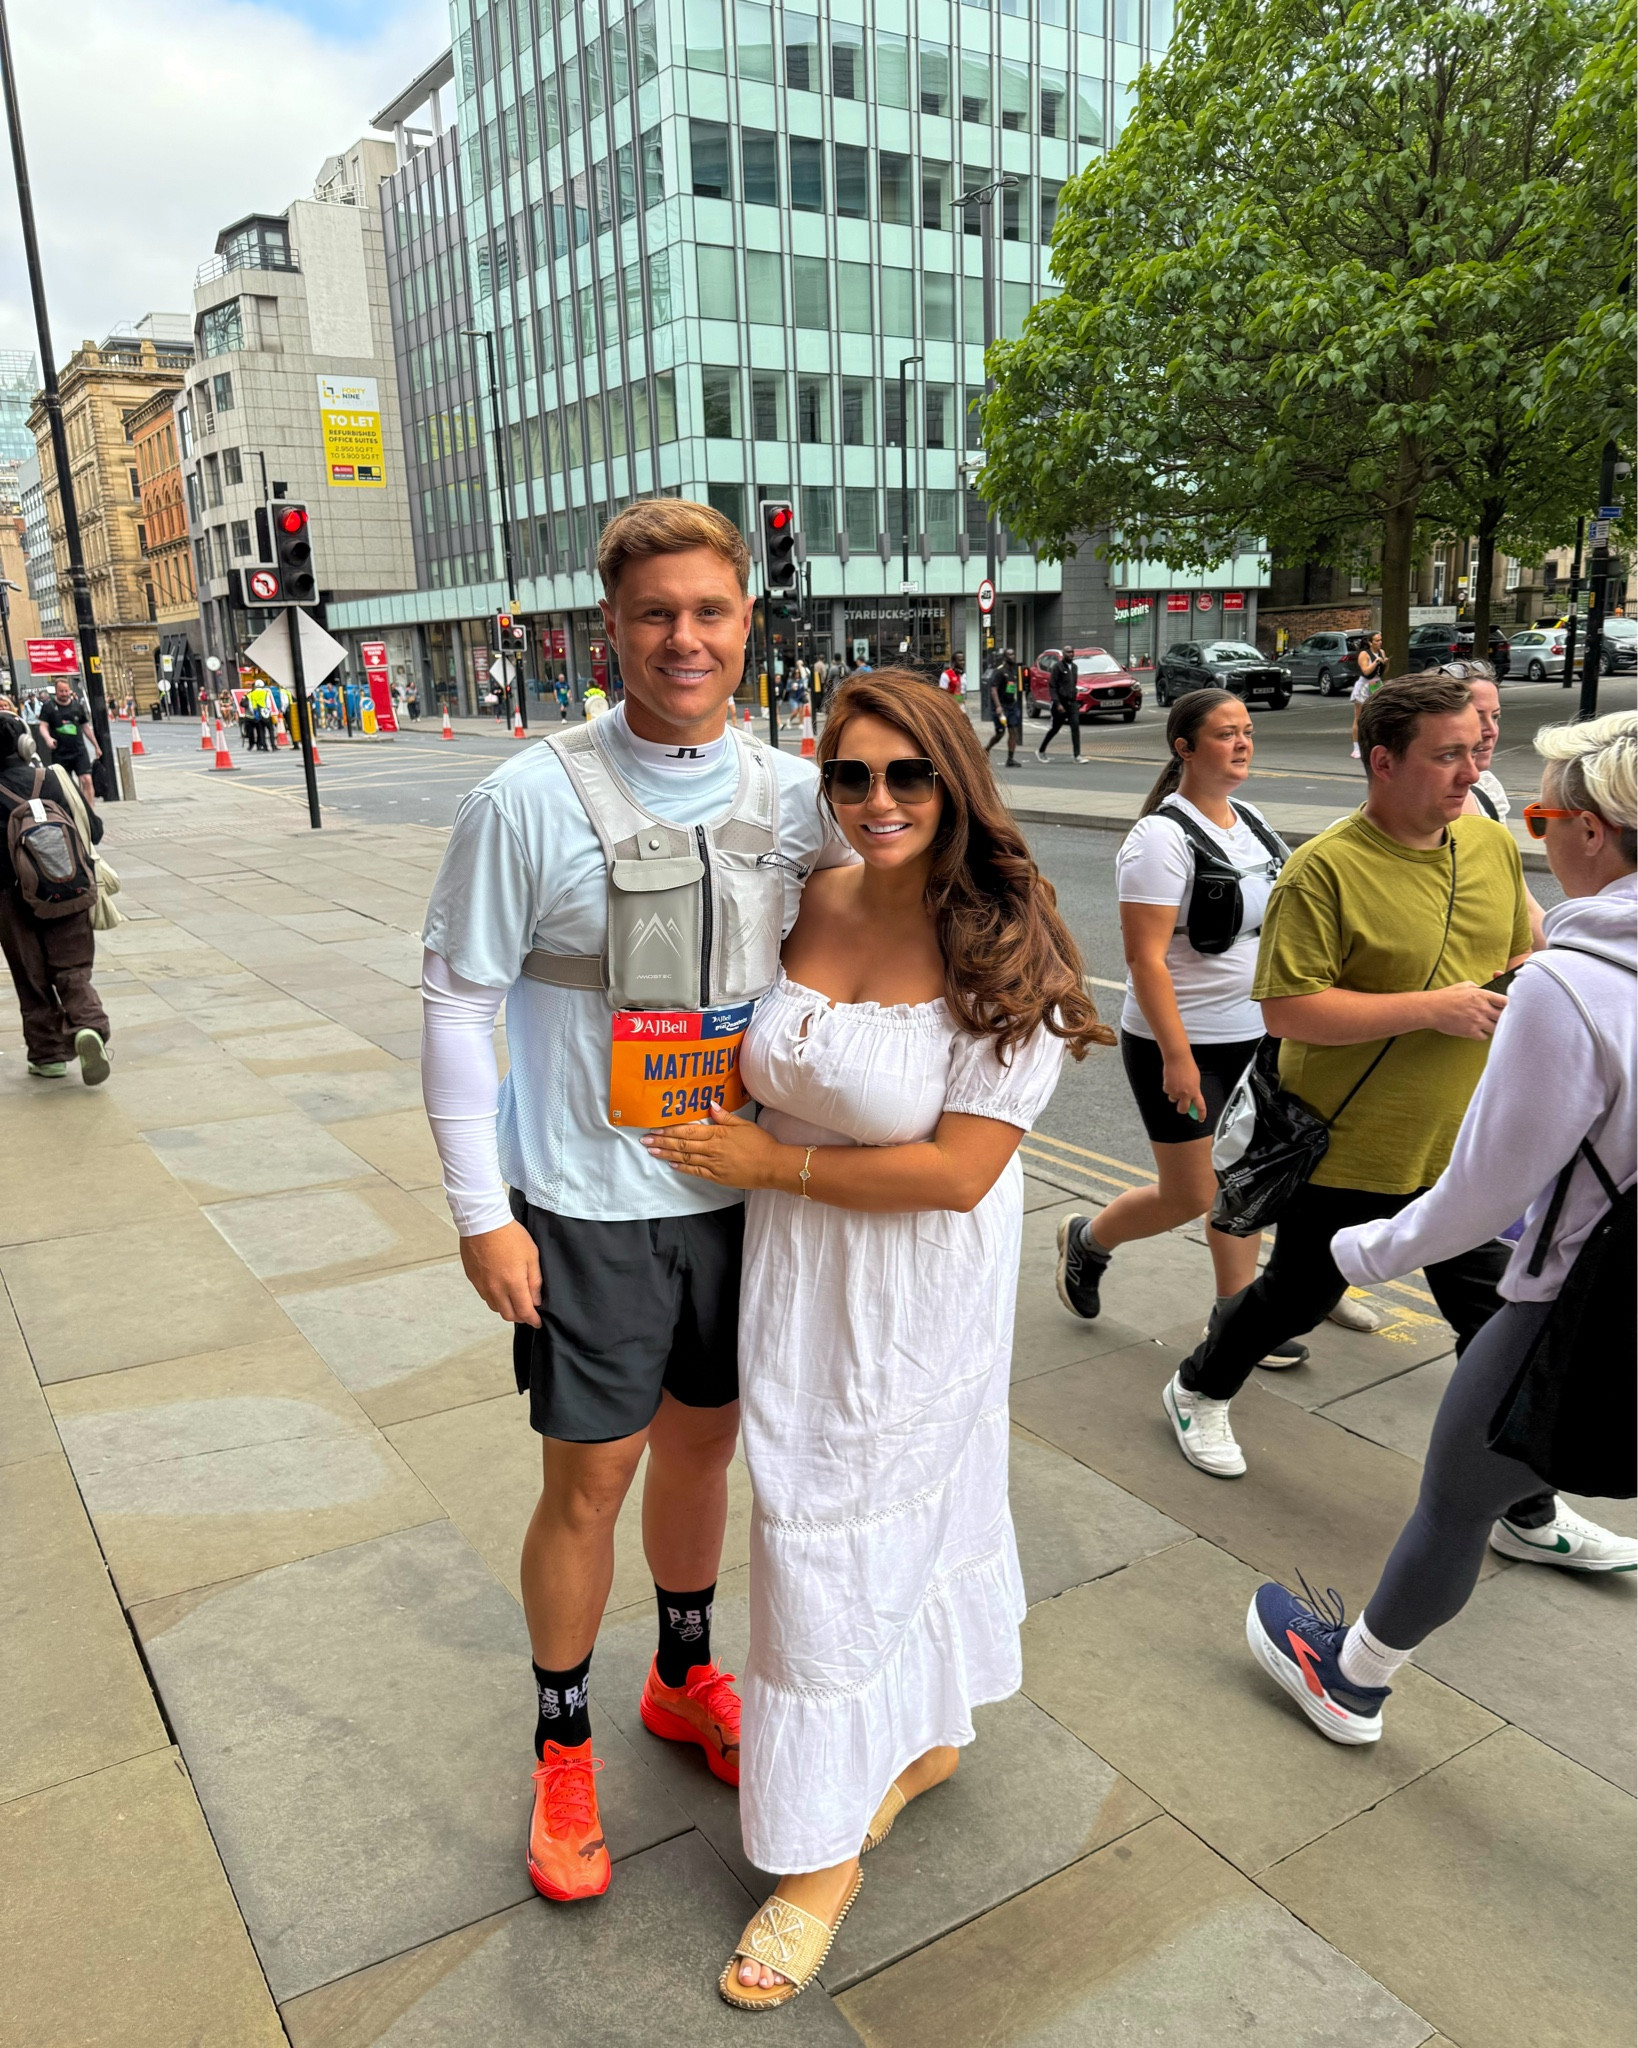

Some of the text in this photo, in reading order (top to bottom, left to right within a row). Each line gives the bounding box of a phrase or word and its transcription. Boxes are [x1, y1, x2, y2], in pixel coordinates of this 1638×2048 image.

[328, 414, 374, 428] TO LET
[328, 429, 377, 437] REFURBISHED
[843, 609, 907, 621] STARBUCKS
[661, 1085, 725, 1118] 23495
